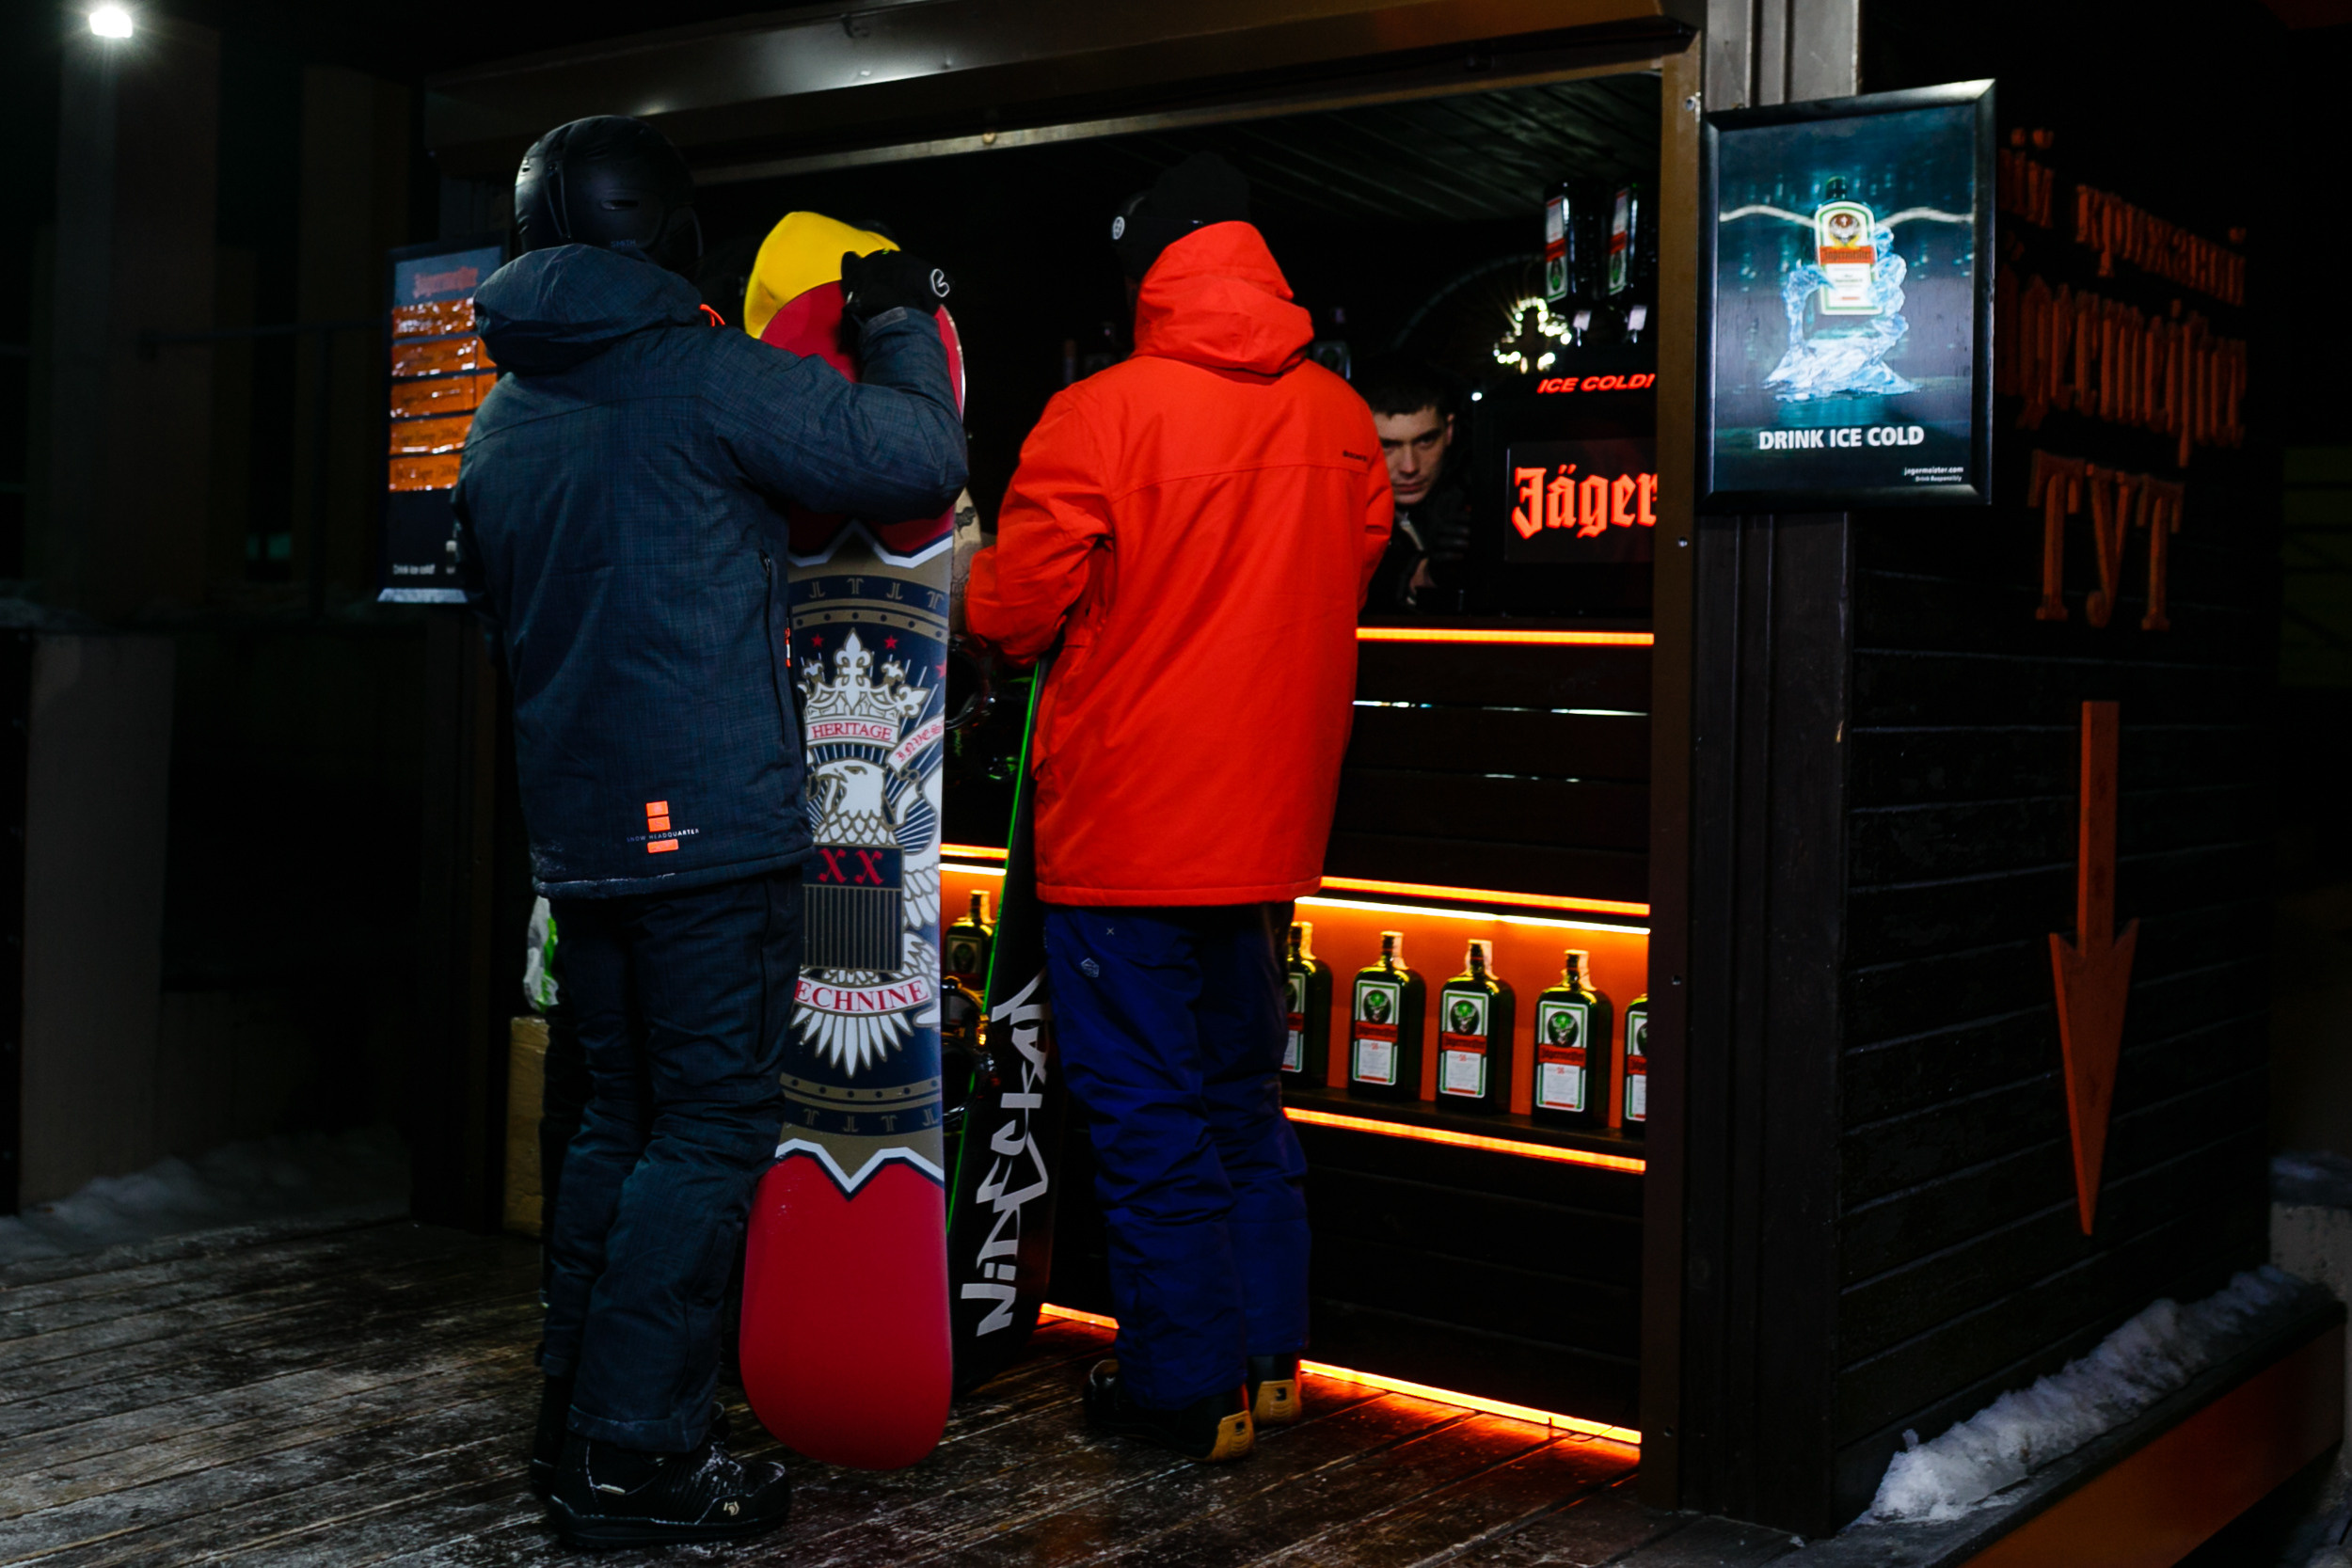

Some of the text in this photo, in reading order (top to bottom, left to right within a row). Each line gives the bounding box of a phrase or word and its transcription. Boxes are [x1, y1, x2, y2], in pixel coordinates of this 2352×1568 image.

[1537, 372, 1656, 394] ICE COLD!
[1759, 425, 1925, 451] DRINK ICE COLD
[811, 722, 893, 741] HERITAGE
